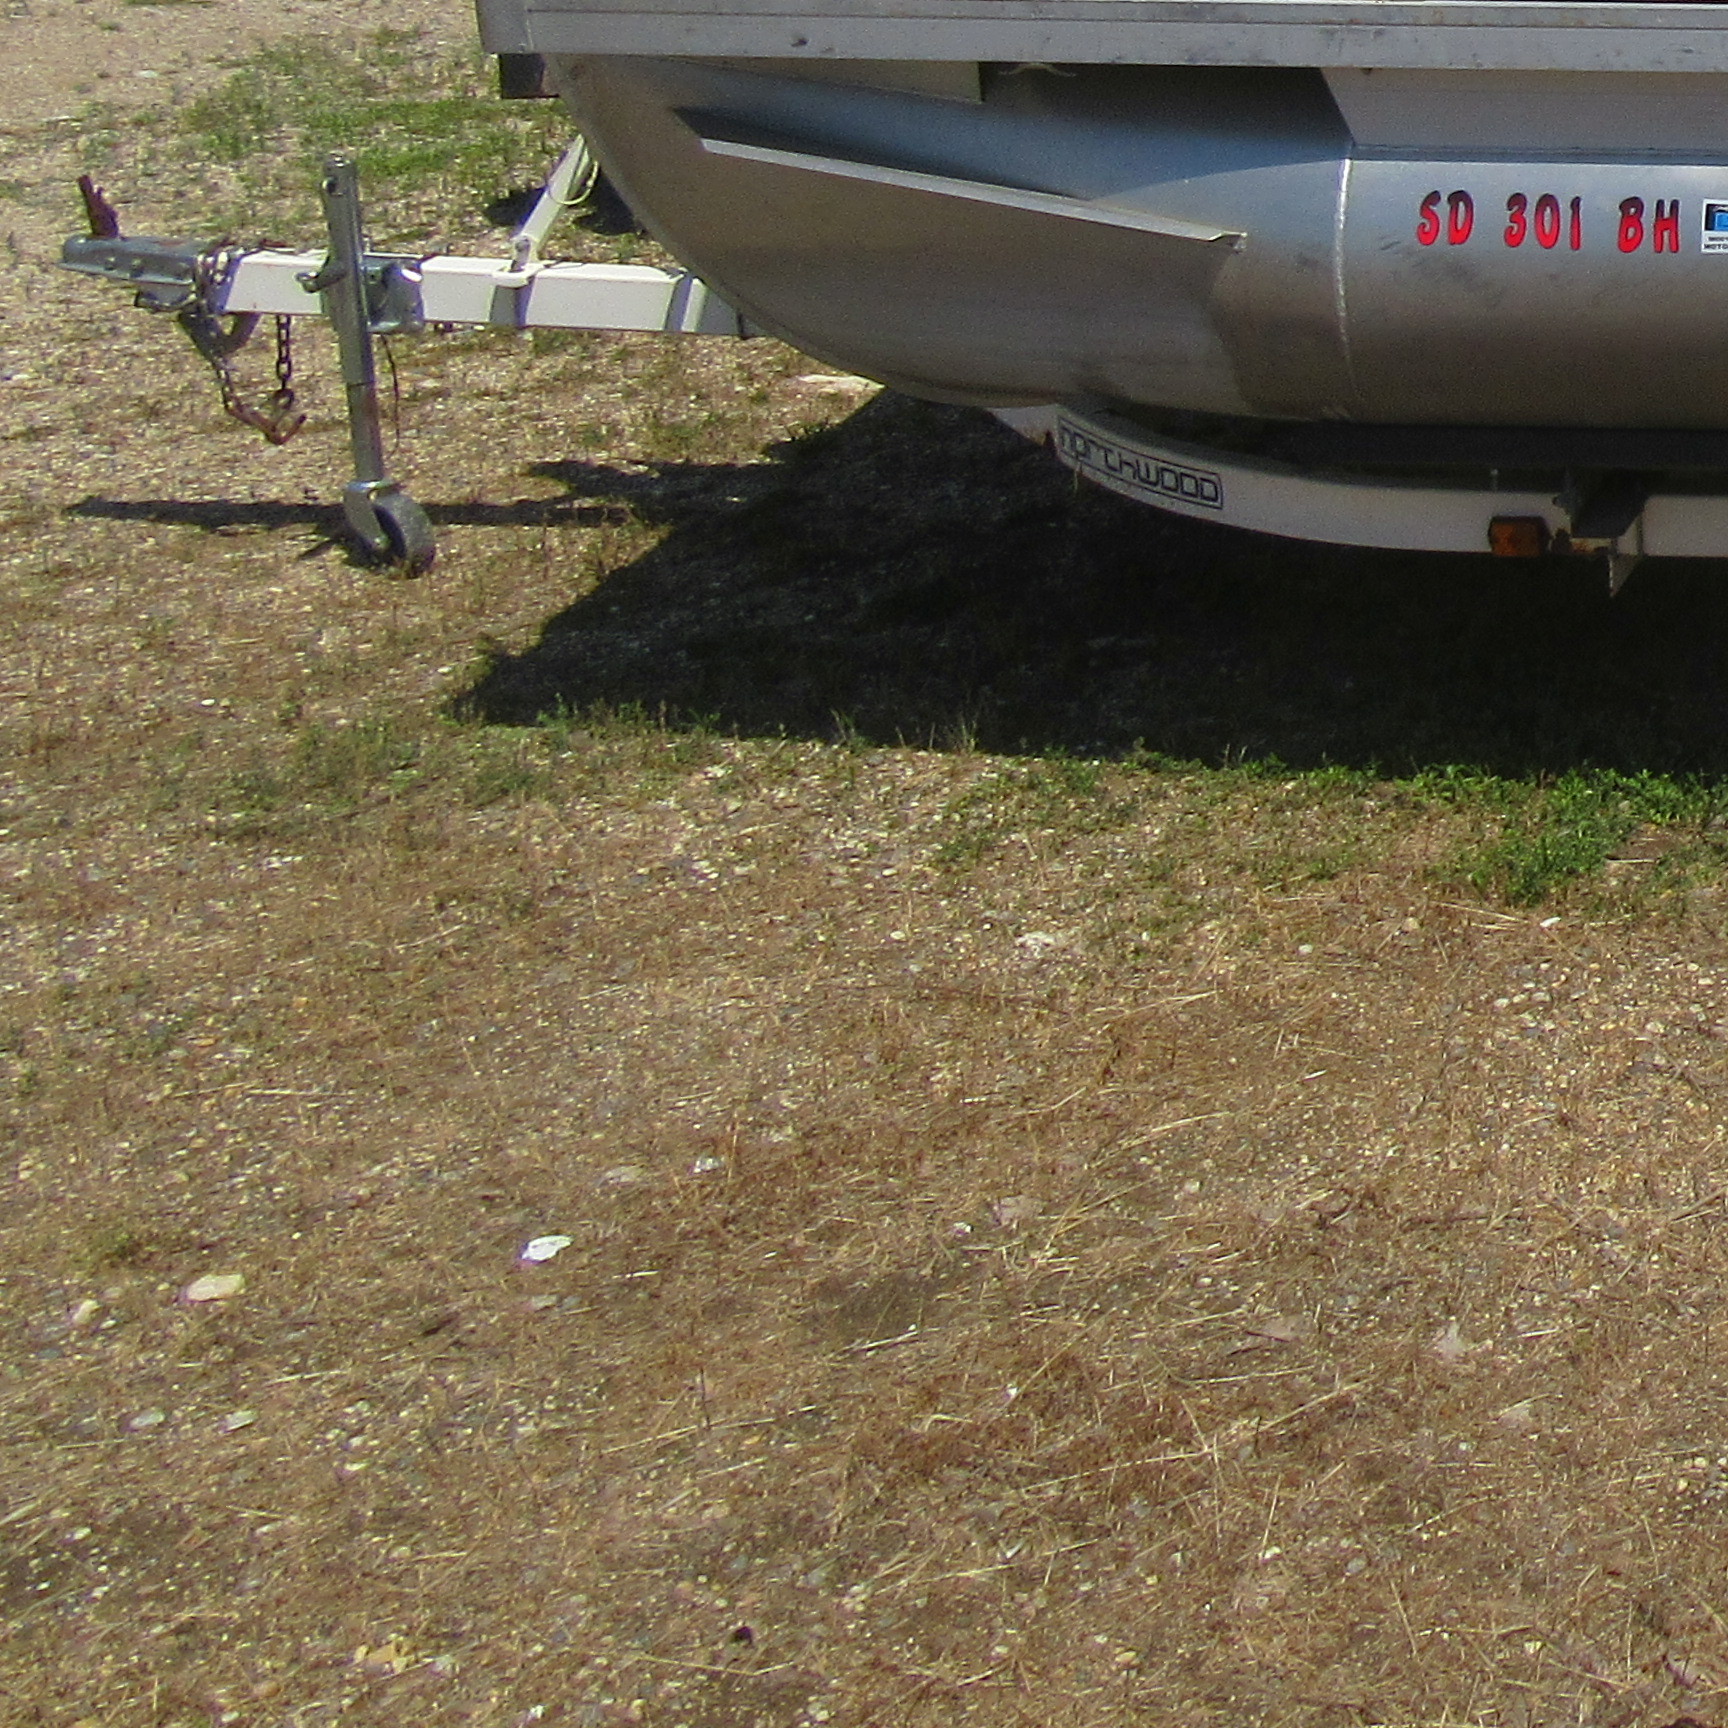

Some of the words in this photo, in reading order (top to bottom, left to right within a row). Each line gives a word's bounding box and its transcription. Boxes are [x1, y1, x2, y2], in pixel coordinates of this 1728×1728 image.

[1416, 189, 1475, 246] SD
[1503, 192, 1583, 251] 301
[1617, 196, 1681, 254] BH
